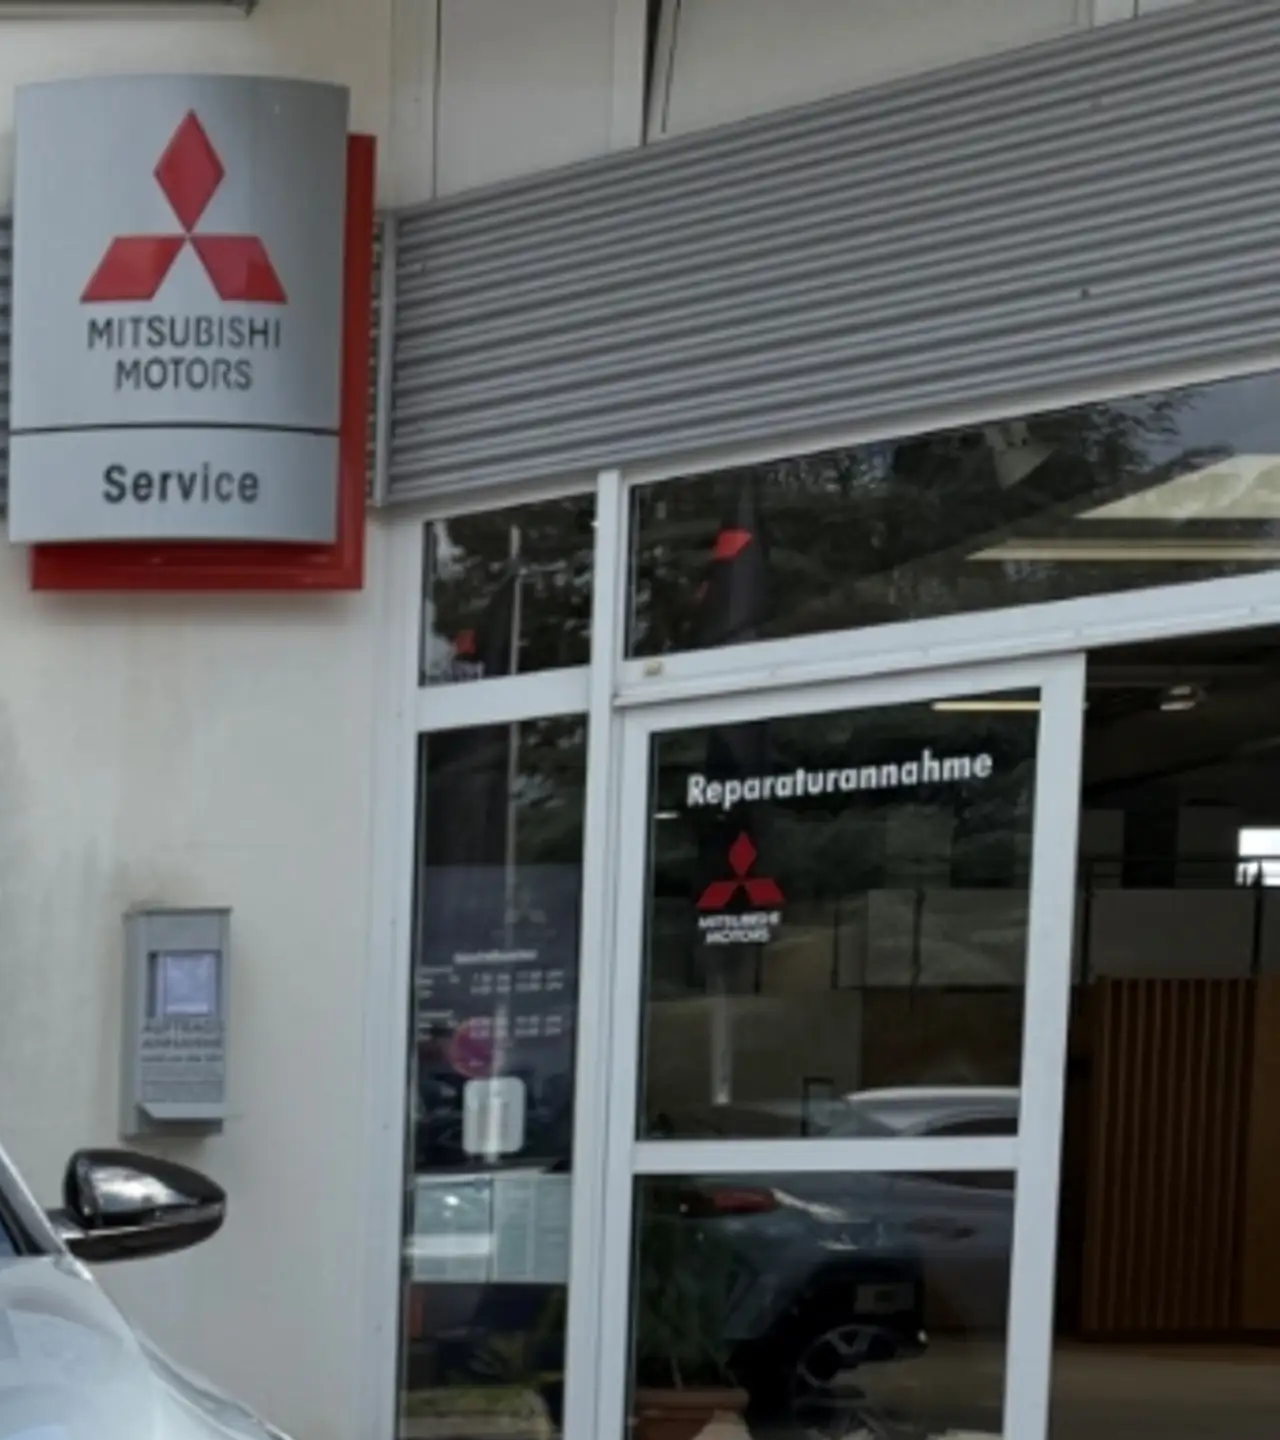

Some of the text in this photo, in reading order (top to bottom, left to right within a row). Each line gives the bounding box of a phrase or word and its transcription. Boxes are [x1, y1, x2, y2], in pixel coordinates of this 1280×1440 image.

[86, 313, 282, 352] MITSUBISHI
[114, 355, 255, 393] MOTORS
[102, 461, 261, 506] Service
[685, 747, 994, 811] Reparaturannahme
